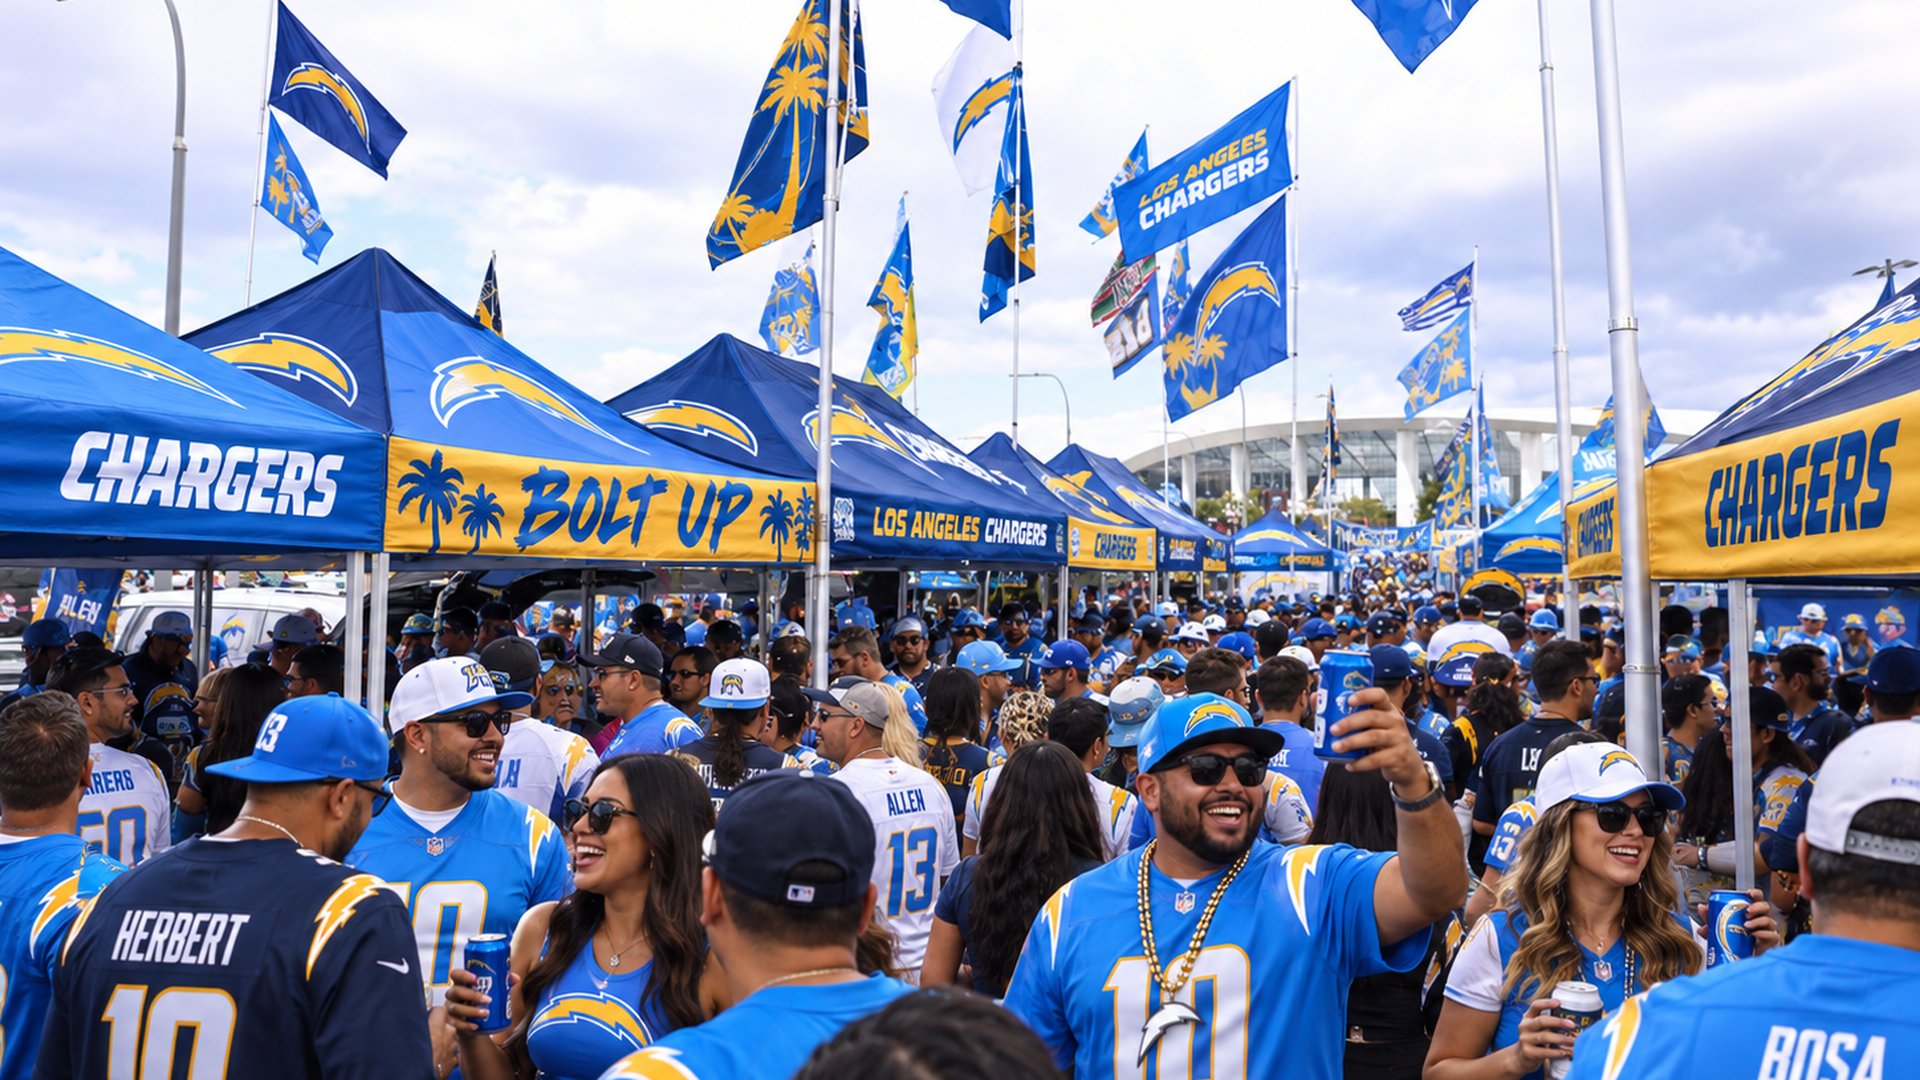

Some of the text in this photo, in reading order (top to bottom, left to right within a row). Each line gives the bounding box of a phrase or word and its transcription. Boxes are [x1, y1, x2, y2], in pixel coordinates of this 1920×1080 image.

[1138, 128, 1267, 208] LOS ANGEES
[1138, 148, 1269, 230] CHARGERS
[60, 431, 345, 518] CHARGERS
[513, 465, 669, 553] BOLT
[677, 479, 753, 554] UP
[1705, 418, 1901, 548] CHARGERS
[873, 506, 908, 537] LOS
[910, 511, 980, 543] ANGELES
[985, 517, 1048, 547] CHARGERS
[886, 788, 926, 817] ALLEN
[886, 826, 938, 919] 13
[111, 910, 251, 966] HERBERT
[101, 983, 238, 1080] 10
[1102, 943, 1251, 1080] 10
[1757, 1025, 1887, 1080] BOSA
